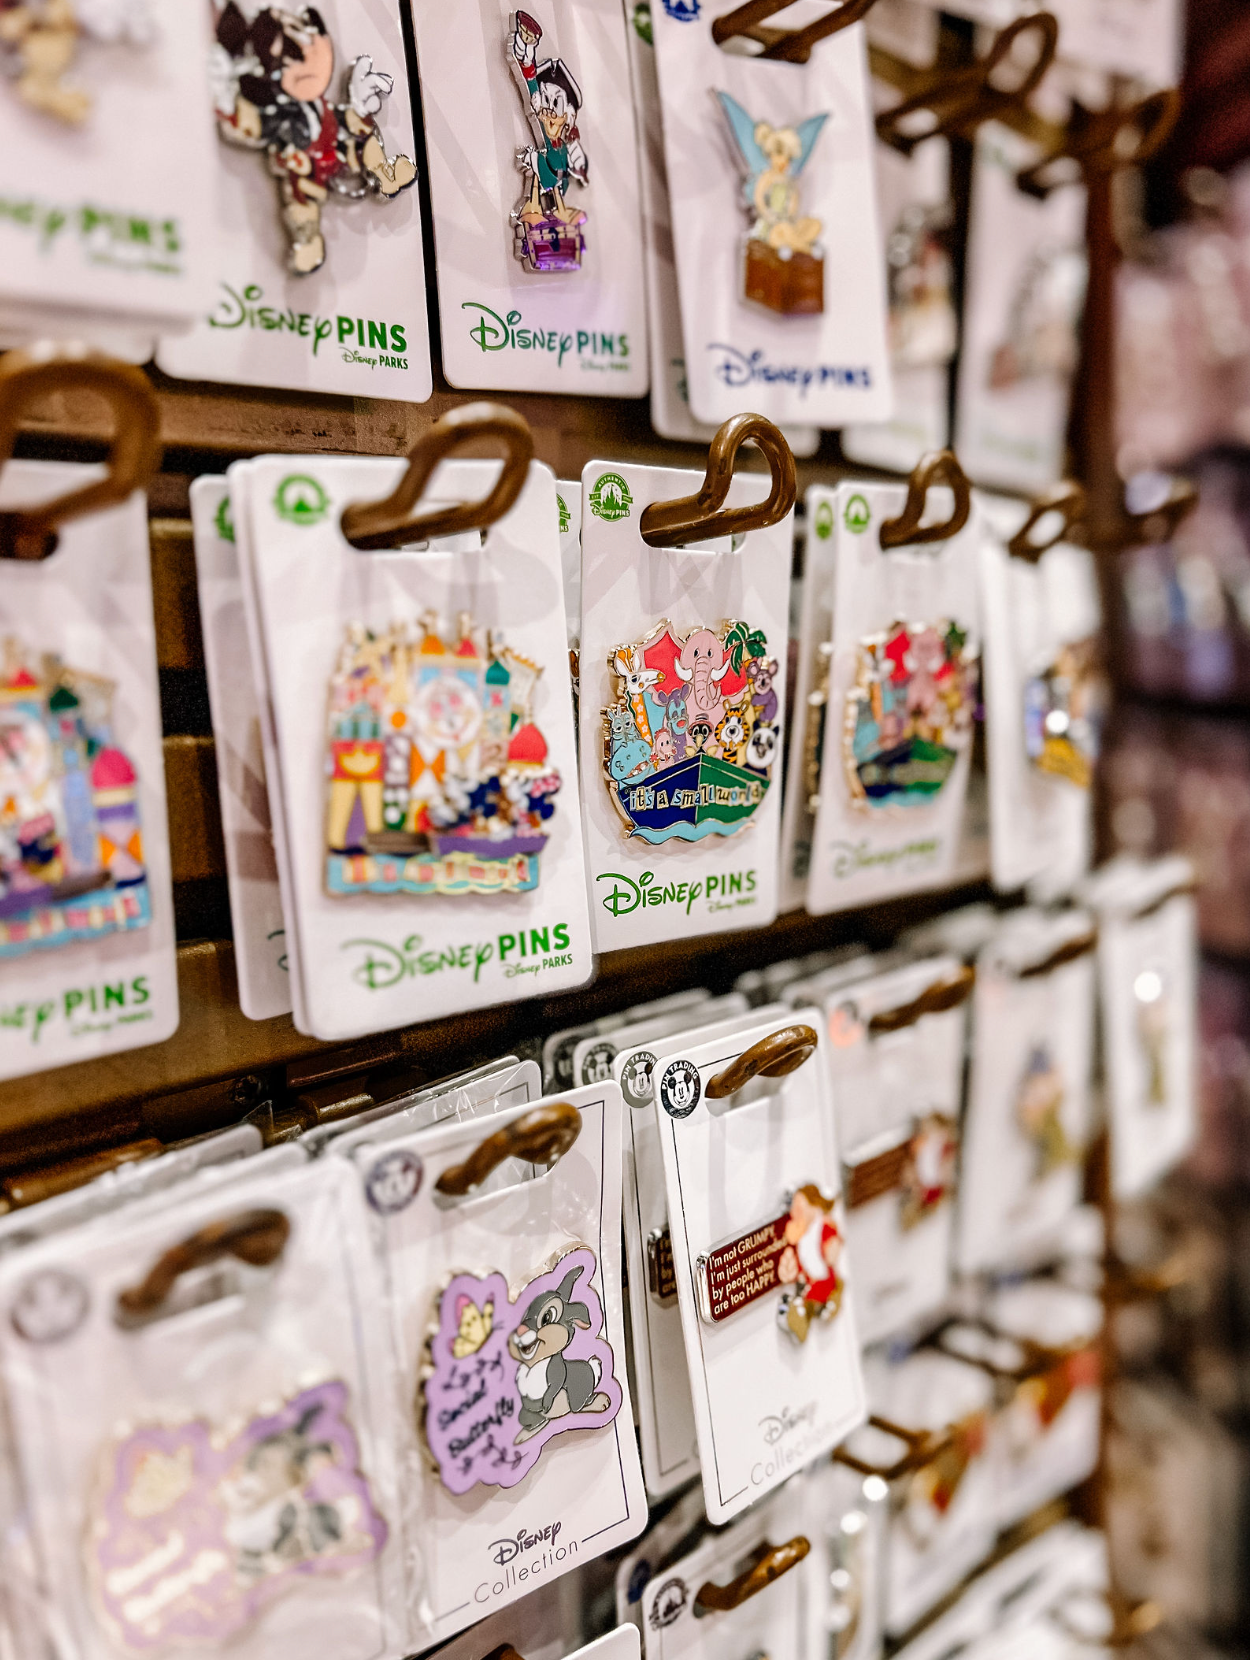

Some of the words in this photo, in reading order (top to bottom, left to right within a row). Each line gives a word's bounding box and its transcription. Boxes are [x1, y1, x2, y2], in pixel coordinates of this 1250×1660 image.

[336, 315, 407, 353] PINS
[461, 302, 572, 368] Disney
[576, 330, 629, 357] PINS
[338, 347, 377, 370] Disney
[379, 355, 409, 370] PARKS
[706, 343, 813, 399] Disney
[657, 790, 669, 809] a
[671, 784, 715, 809] small
[716, 782, 762, 806] world
[596, 871, 702, 917] Disney
[705, 870, 757, 898] PINS
[340, 934, 494, 989] Disney
[498, 923, 571, 961] PINS
[501, 961, 541, 979] Disney
[542, 953, 573, 970] PARKS
[63, 976, 150, 1021] PINS
[622, 1064, 632, 1080] PIN
[630, 1052, 657, 1065] TRADIN
[661, 1072, 670, 1090] PIN
[669, 1061, 699, 1079] TRADING
[709, 1256, 723, 1270] I'm
[723, 1246, 737, 1263] not
[710, 1271, 725, 1286] I'm
[725, 1263, 741, 1281] just
[712, 1286, 724, 1301] by
[725, 1268, 755, 1294] people
[756, 1259, 775, 1275] who
[714, 1299, 729, 1315] are
[730, 1291, 745, 1306] too
[487, 1521, 562, 1566] Disney
[474, 1540, 578, 1603] Collection
